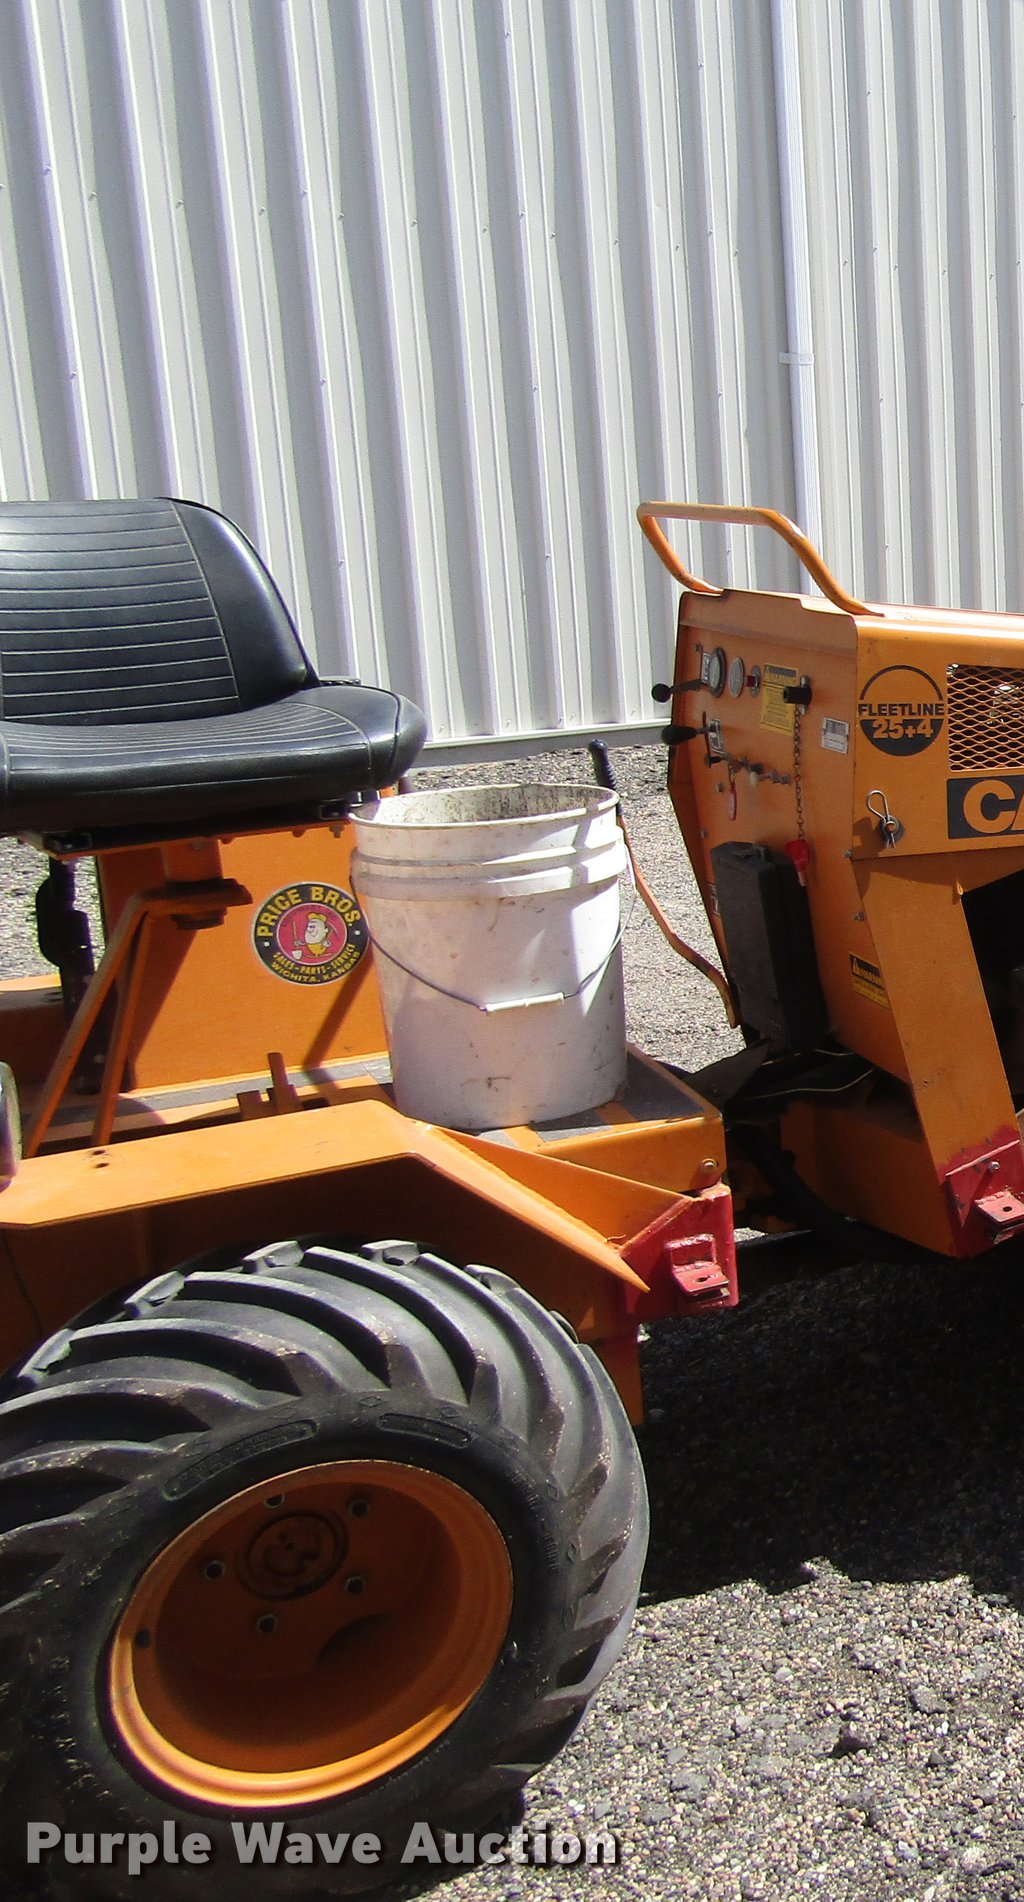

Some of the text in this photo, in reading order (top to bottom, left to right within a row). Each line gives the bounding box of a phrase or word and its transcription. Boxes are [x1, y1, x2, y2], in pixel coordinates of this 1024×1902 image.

[858, 703, 945, 716] FLEETLINE
[872, 719, 934, 739] 25+4
[257, 888, 302, 937] PRICE
[311, 886, 361, 927] BROS.
